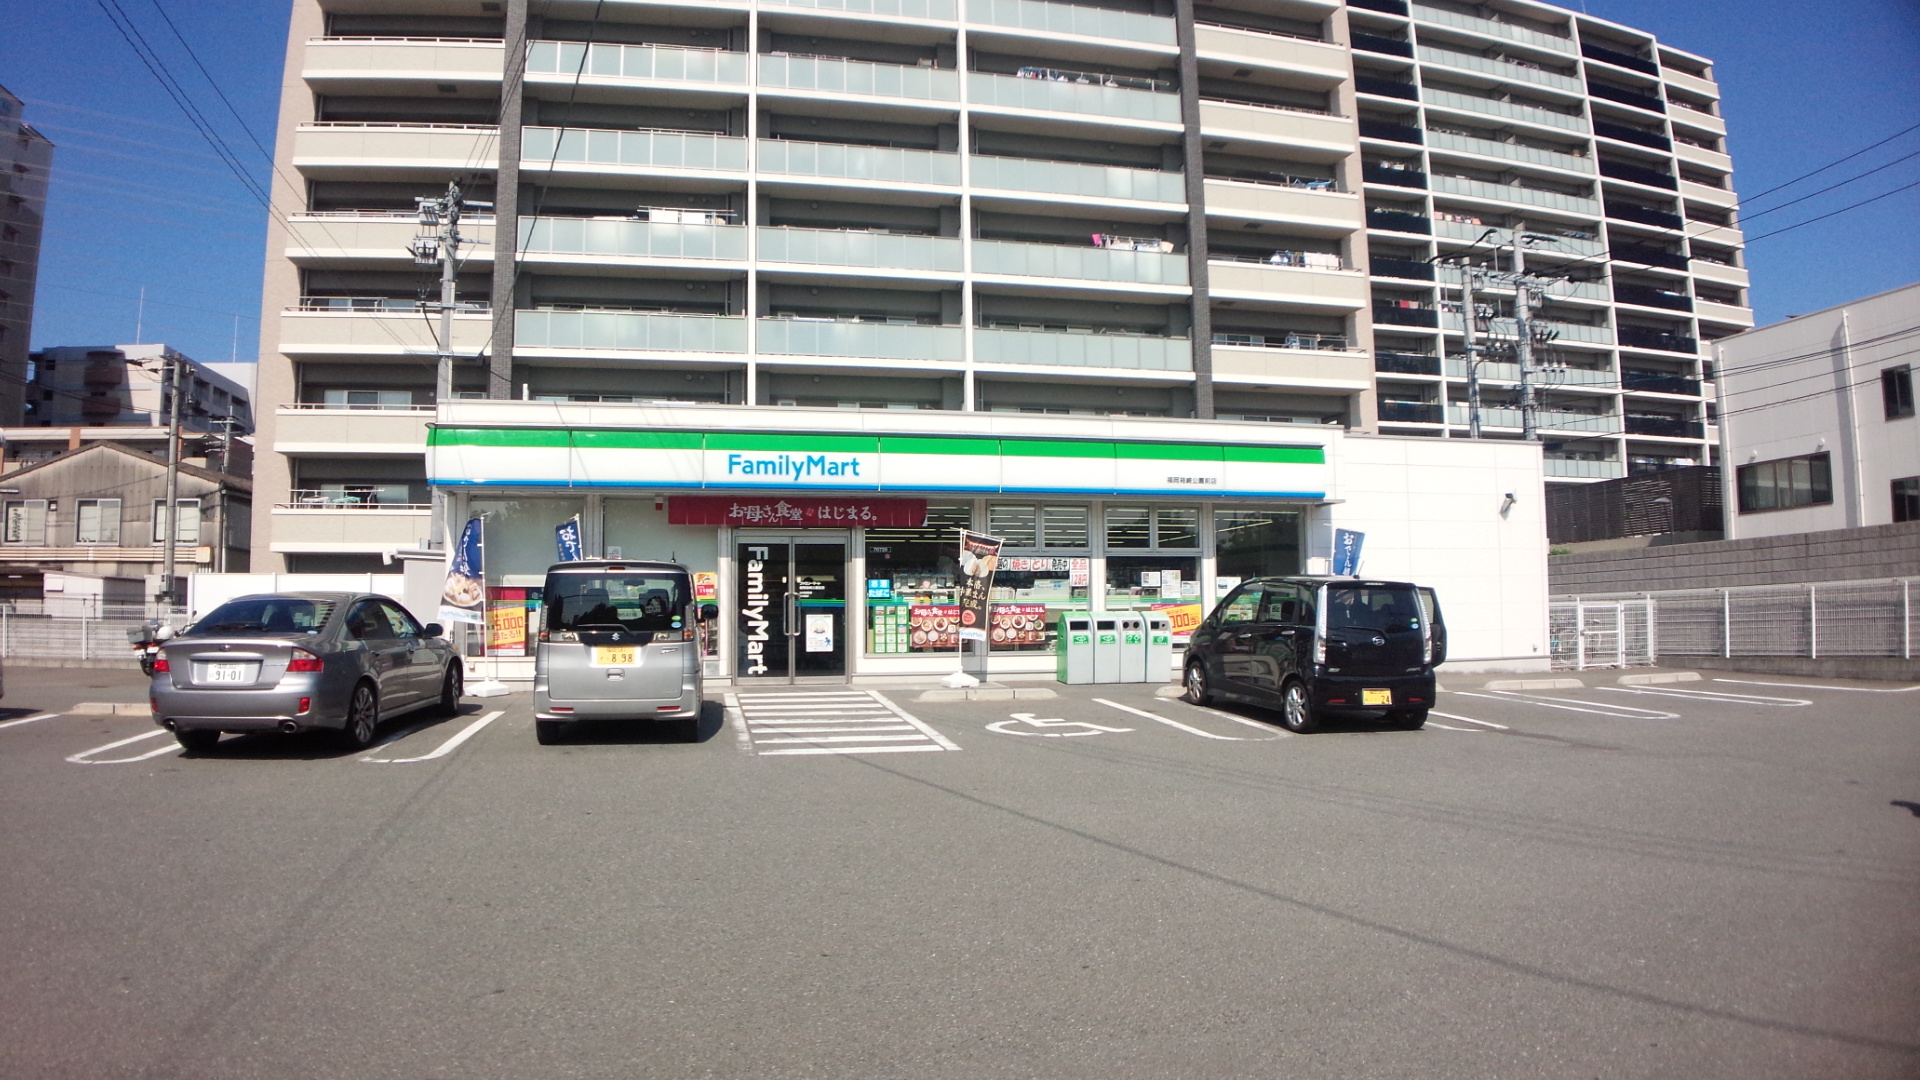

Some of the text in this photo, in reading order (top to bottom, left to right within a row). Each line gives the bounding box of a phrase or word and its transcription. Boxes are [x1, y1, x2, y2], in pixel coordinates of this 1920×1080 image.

[728, 454, 860, 481] FamilyMart
[729, 500, 878, 523] お母さん食堂 はじまる。
[1071, 559, 1087, 570] 全品
[741, 546, 769, 675] FamilyMart
[215, 670, 242, 681] 91-01
